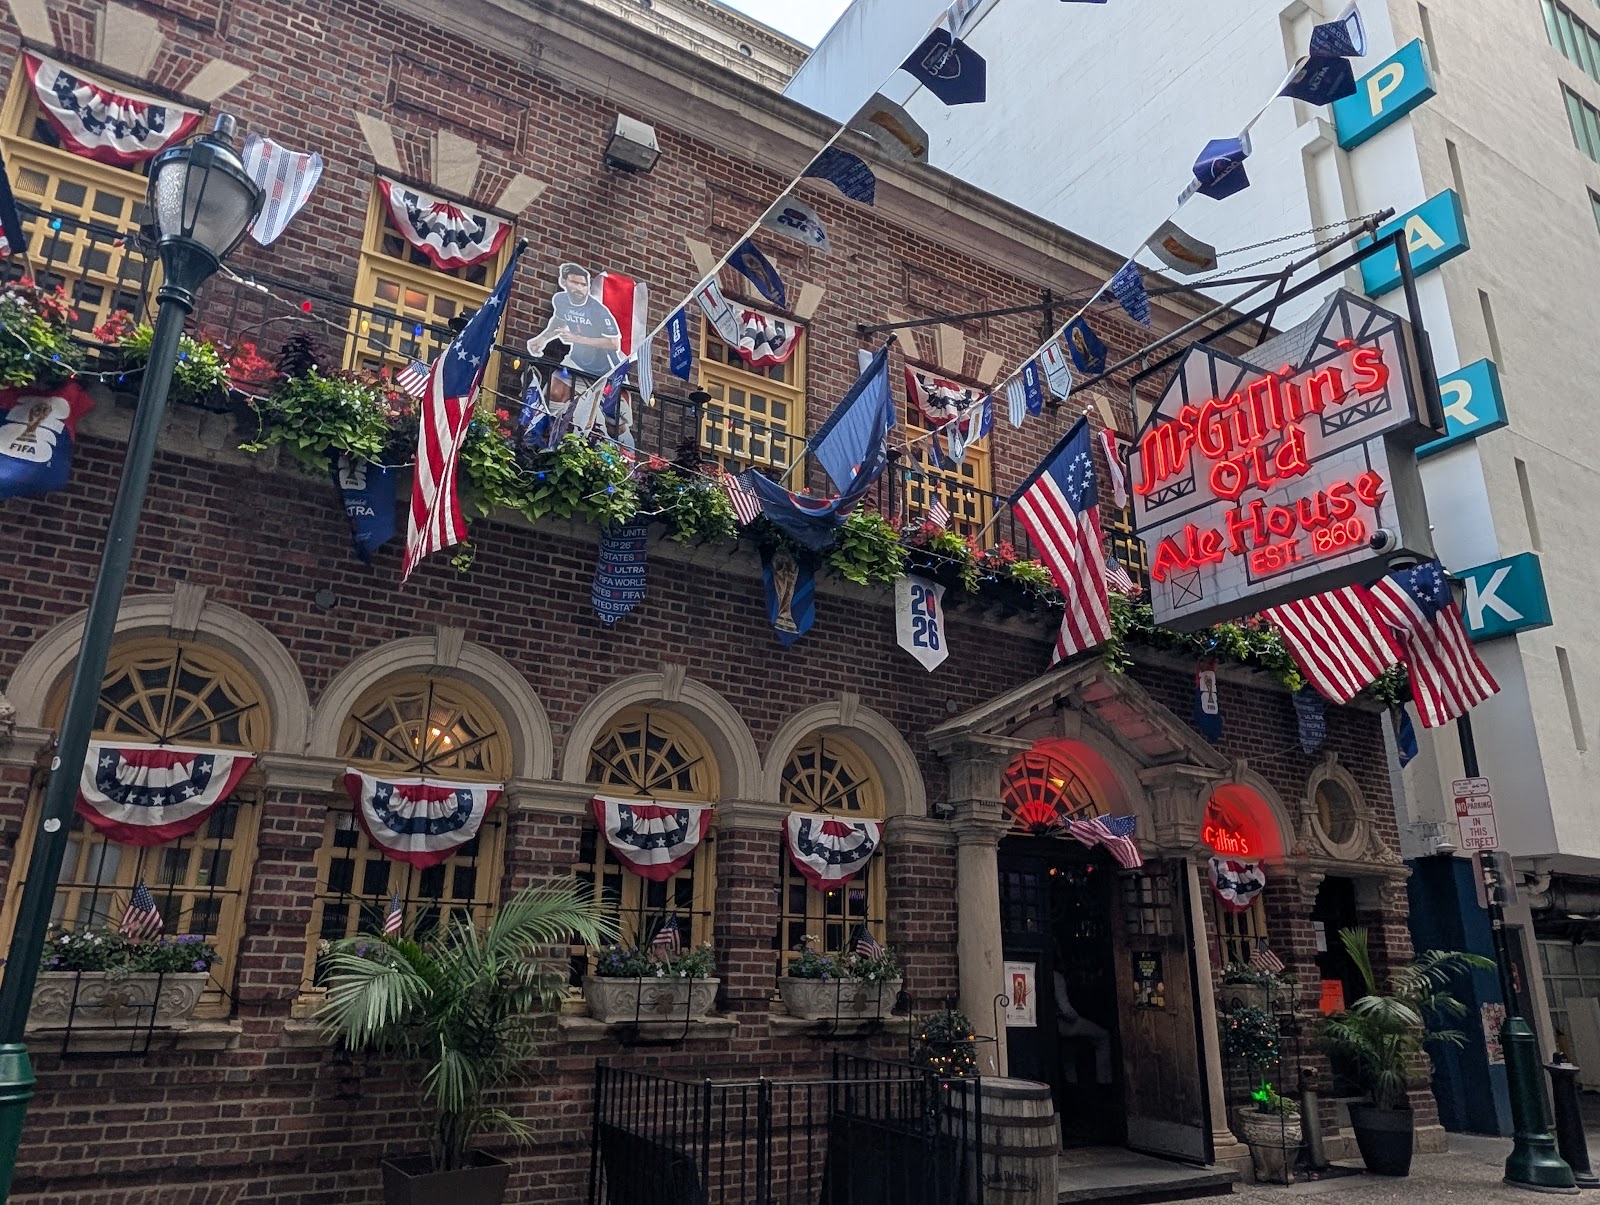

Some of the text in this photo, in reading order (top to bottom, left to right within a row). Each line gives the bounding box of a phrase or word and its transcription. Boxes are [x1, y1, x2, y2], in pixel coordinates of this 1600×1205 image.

[564, 313, 593, 326] ULTRA
[1134, 338, 1390, 496] McGillin's
[9, 443, 36, 455] FIFA
[1209, 424, 1313, 501] Old
[1152, 469, 1388, 584] Ale House
[622, 528, 647, 538] UNITE
[1311, 517, 1367, 555] 1860
[603, 552, 635, 562] STATES
[614, 566, 646, 574] ULTRA
[622, 591, 641, 600] FIFA
[592, 597, 635, 613] NITED STAT
[912, 616, 940, 651] 26
[1455, 801, 1491, 813] NO PARKING
[1472, 817, 1481, 826] IN
[1469, 827, 1488, 836] THIS
[1465, 837, 1495, 847] STREET
